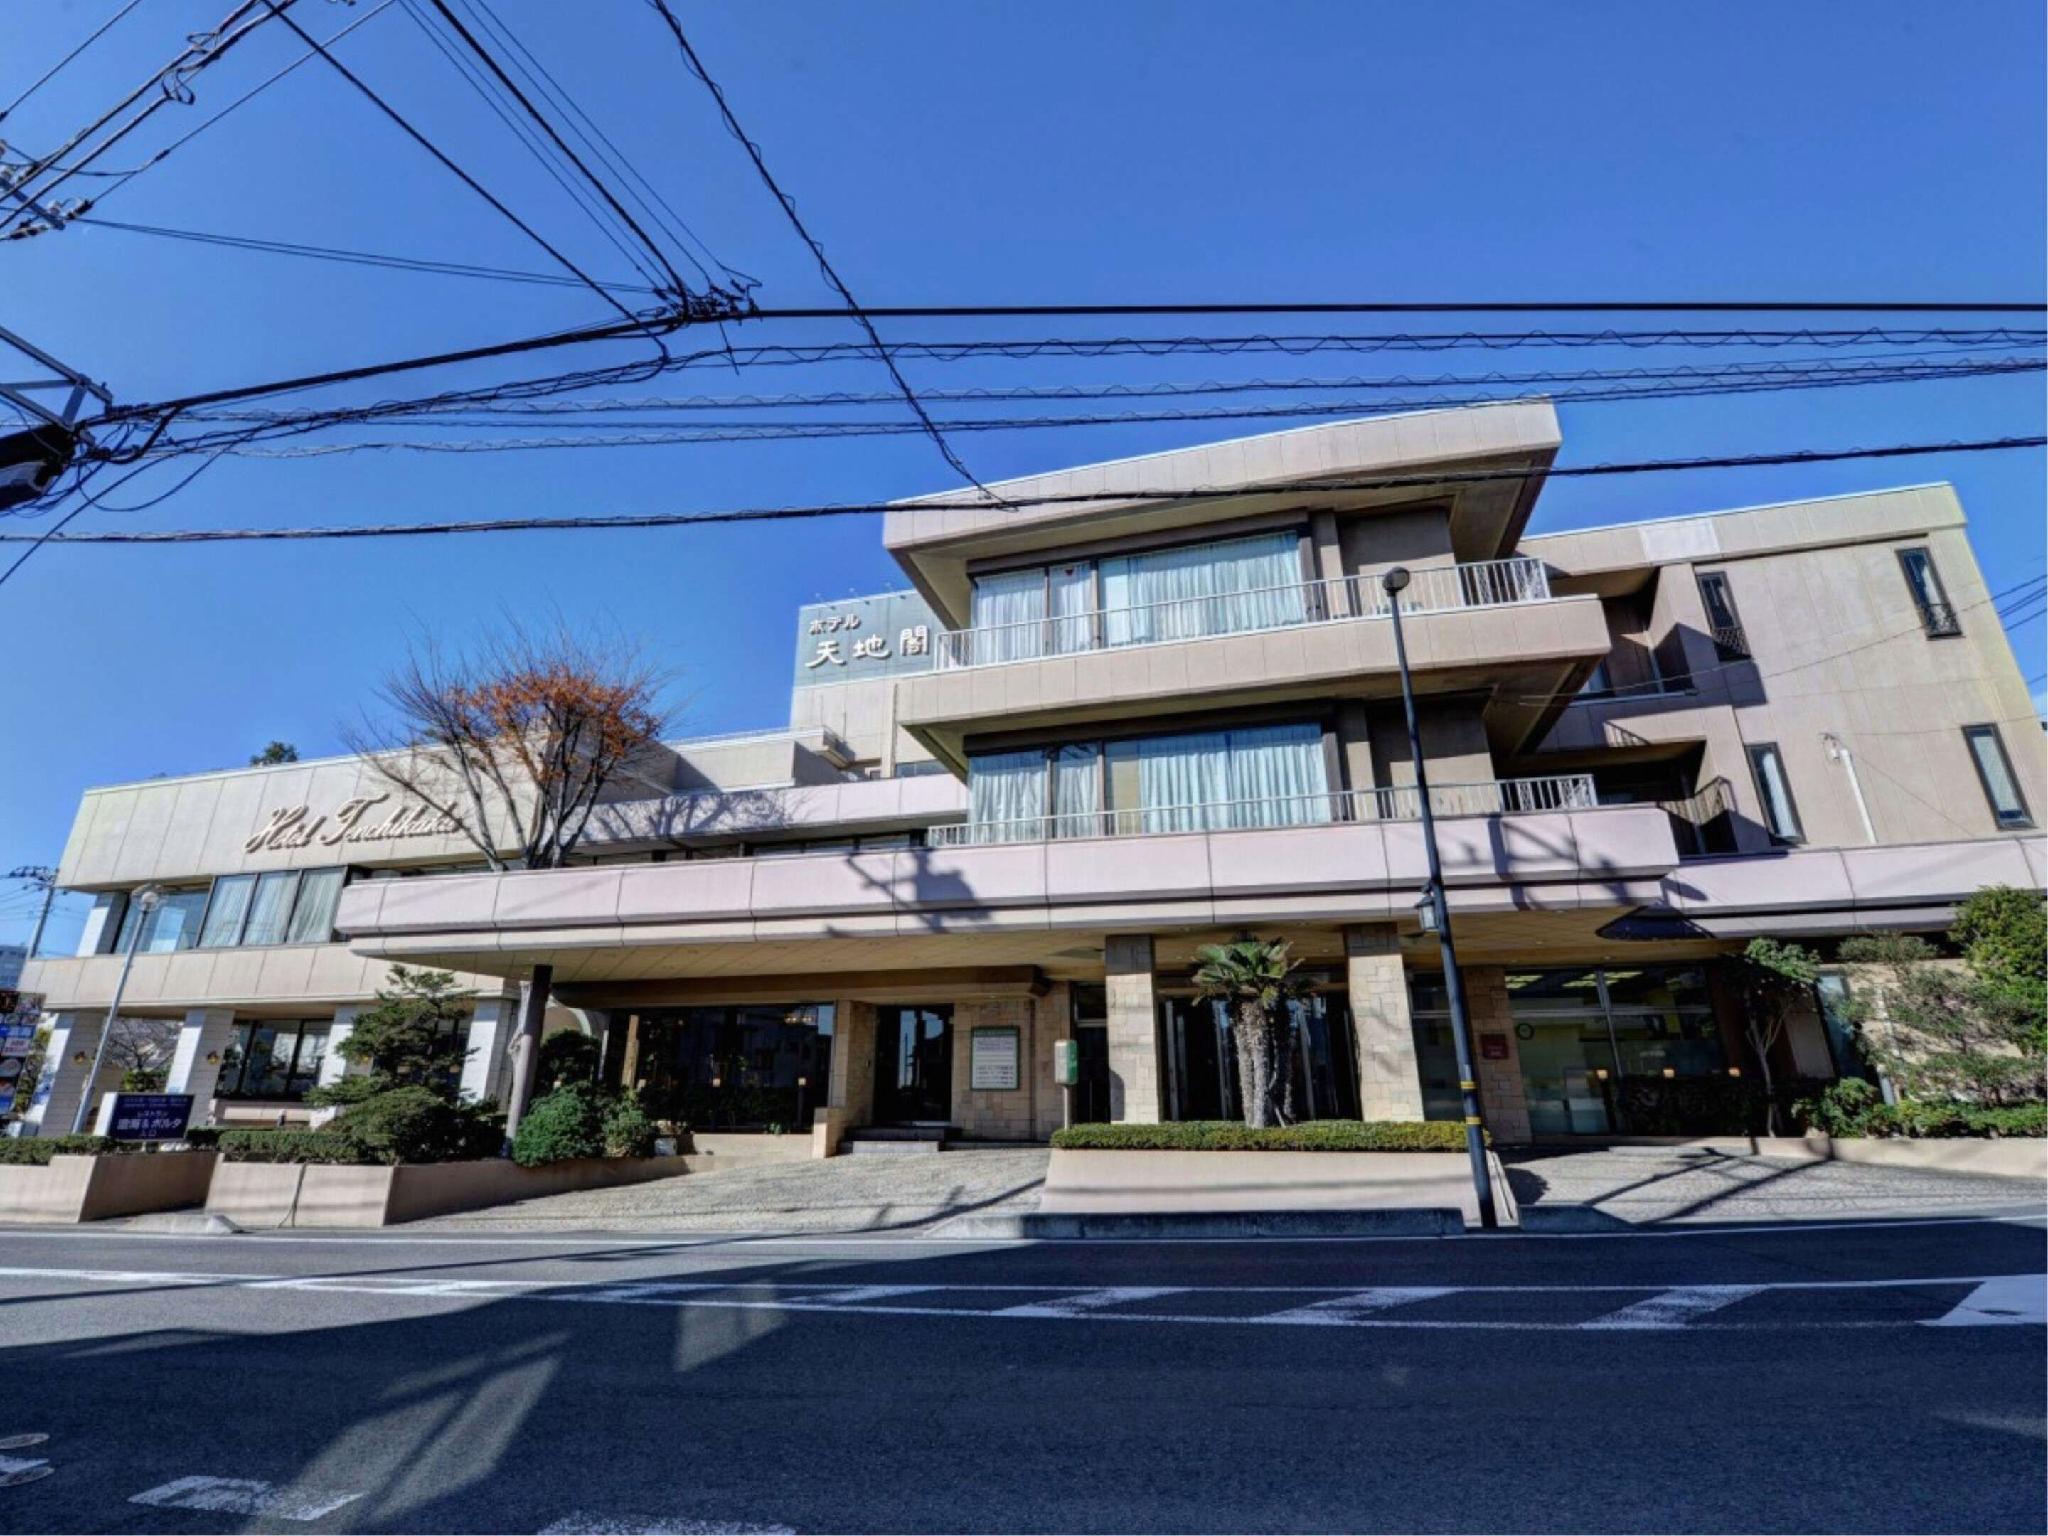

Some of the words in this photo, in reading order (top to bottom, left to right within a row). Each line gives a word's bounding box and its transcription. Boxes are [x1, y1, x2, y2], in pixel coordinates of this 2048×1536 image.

[804, 624, 930, 668] 天地閣
[808, 613, 862, 635] ホテル
[245, 805, 328, 854] Hotel
